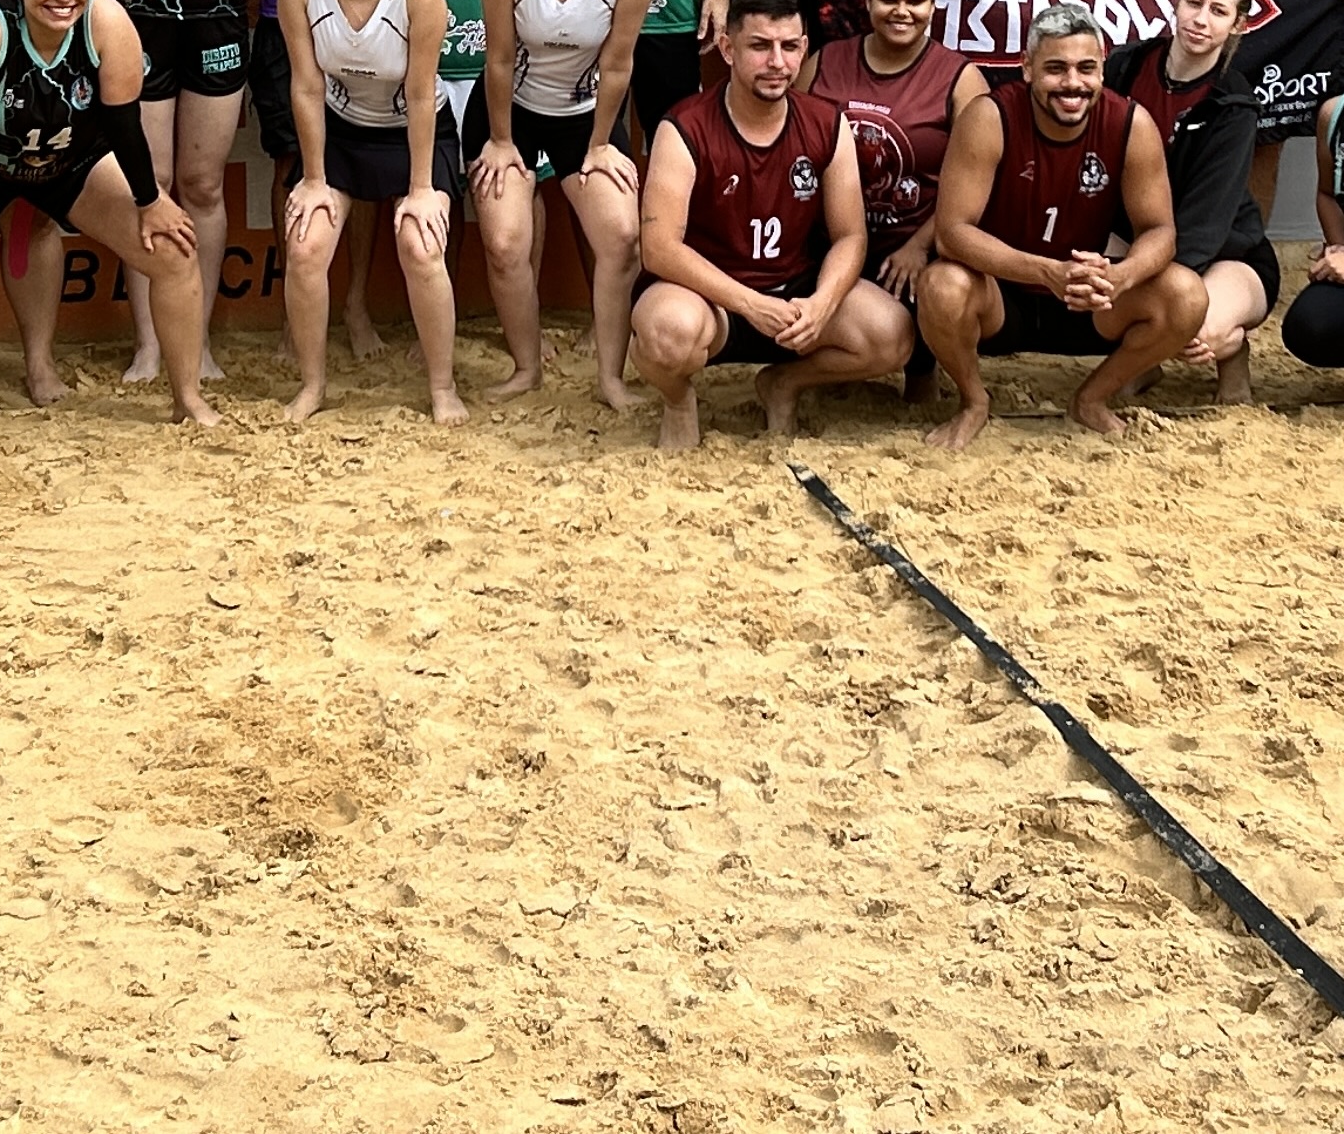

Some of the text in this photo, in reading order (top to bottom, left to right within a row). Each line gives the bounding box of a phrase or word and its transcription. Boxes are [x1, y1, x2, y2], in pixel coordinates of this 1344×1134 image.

[21, 126, 73, 151] 14
[749, 216, 782, 260] 12
[1042, 206, 1058, 243] 1
